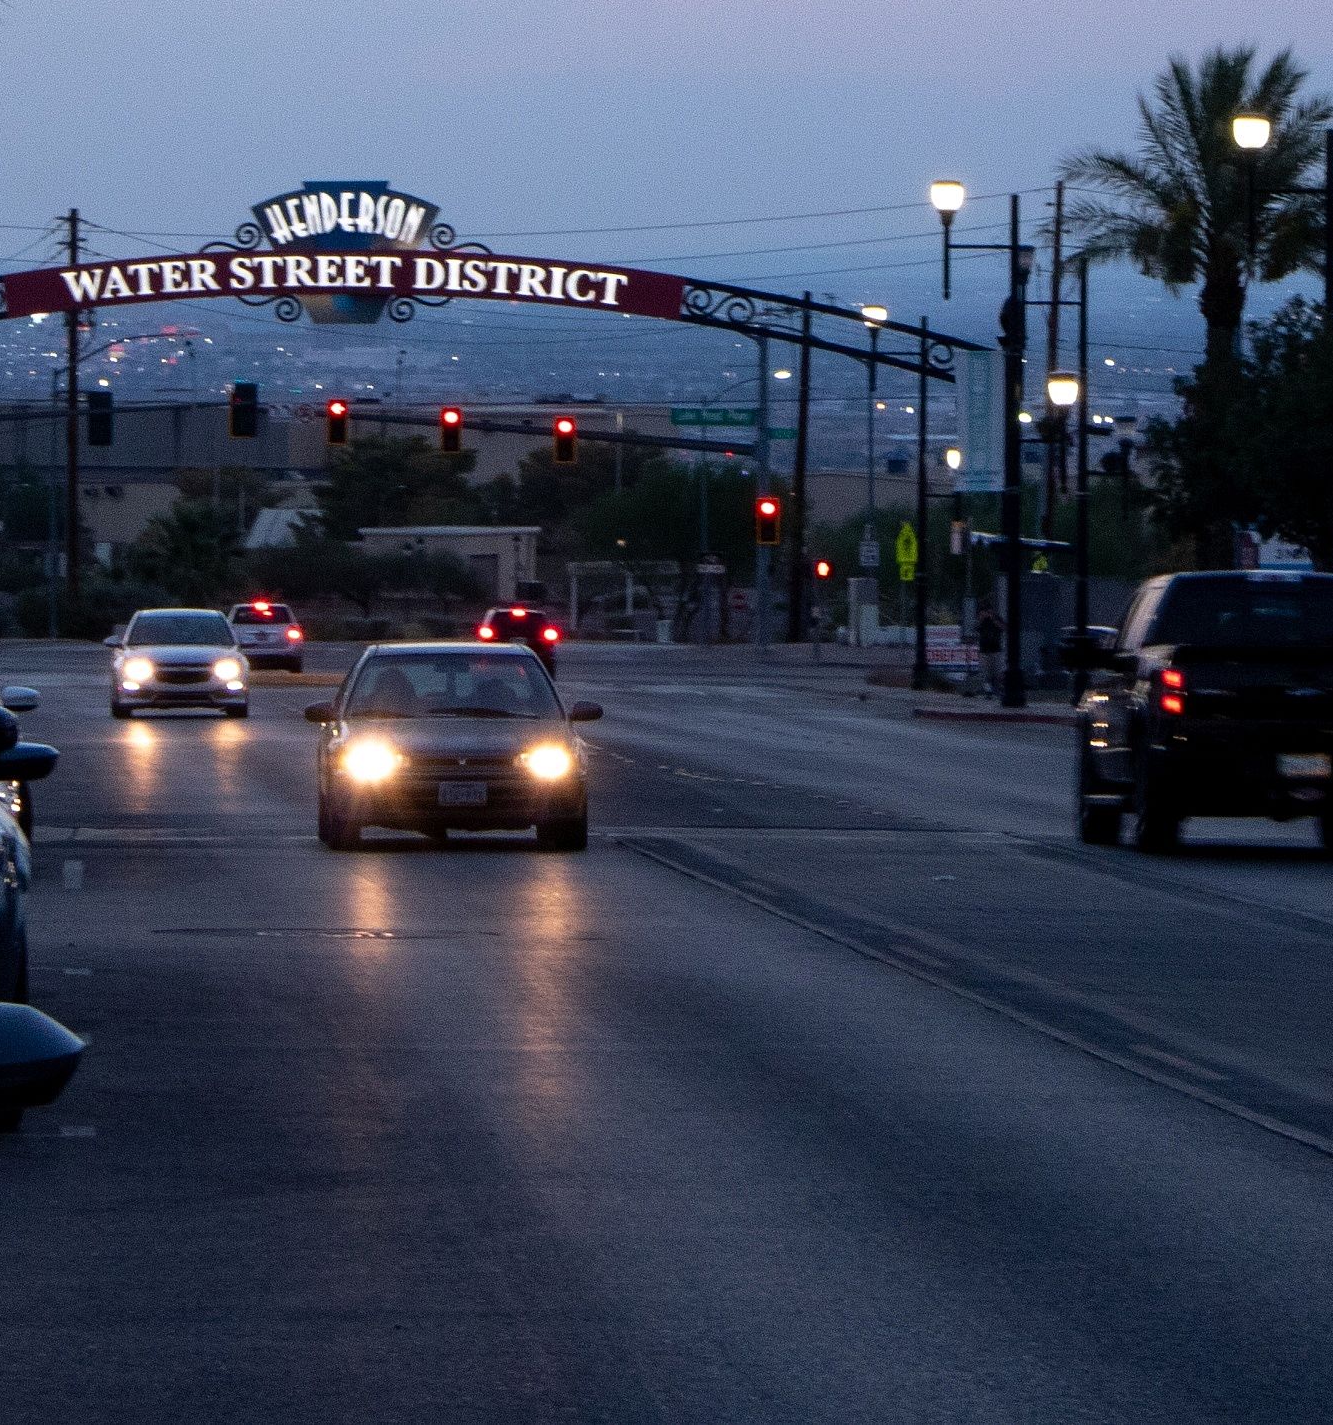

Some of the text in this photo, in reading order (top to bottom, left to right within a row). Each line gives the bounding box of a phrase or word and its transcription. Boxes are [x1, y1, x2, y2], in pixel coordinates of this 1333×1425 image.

[262, 191, 427, 245] HENDERSON
[60, 255, 628, 306] WATER STREET DISTRICT
